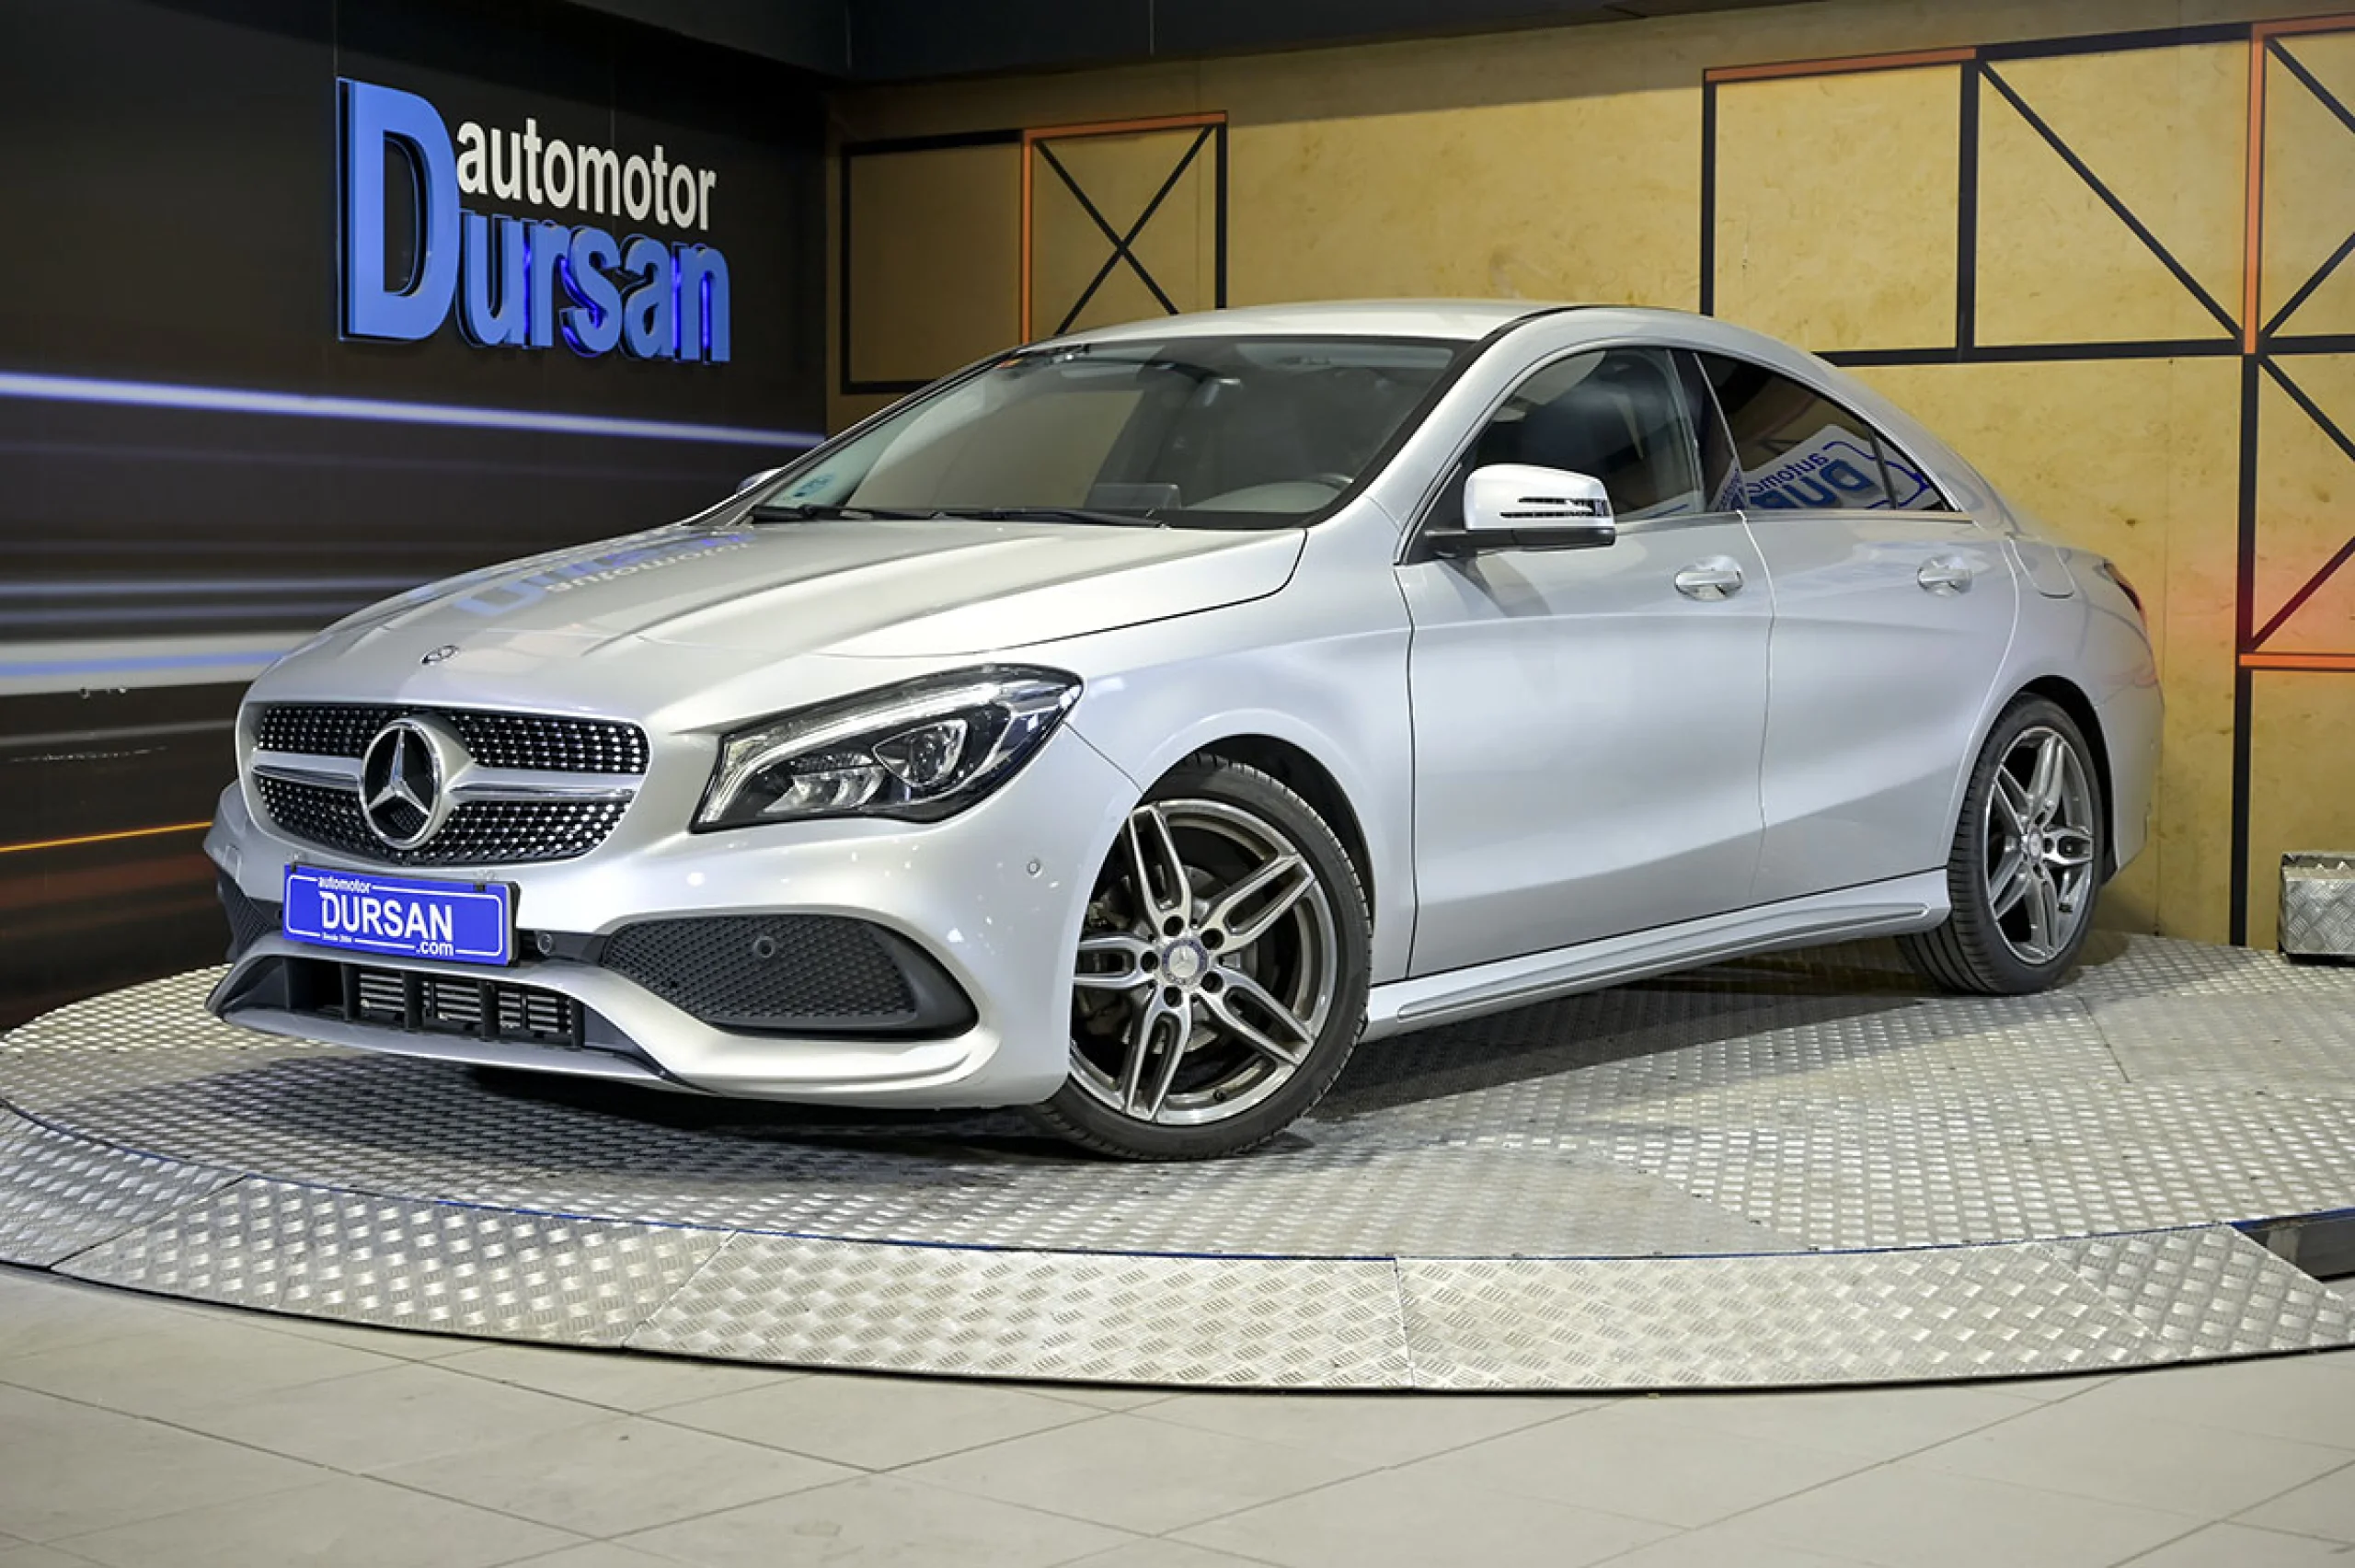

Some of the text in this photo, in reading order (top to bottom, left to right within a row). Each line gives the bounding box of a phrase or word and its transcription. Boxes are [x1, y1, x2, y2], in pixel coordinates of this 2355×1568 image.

[457, 118, 717, 231] automotor
[337, 76, 730, 364] Dursan
[318, 876, 371, 894] automotor
[319, 890, 453, 943] DURSAN
[416, 941, 454, 956] .com
